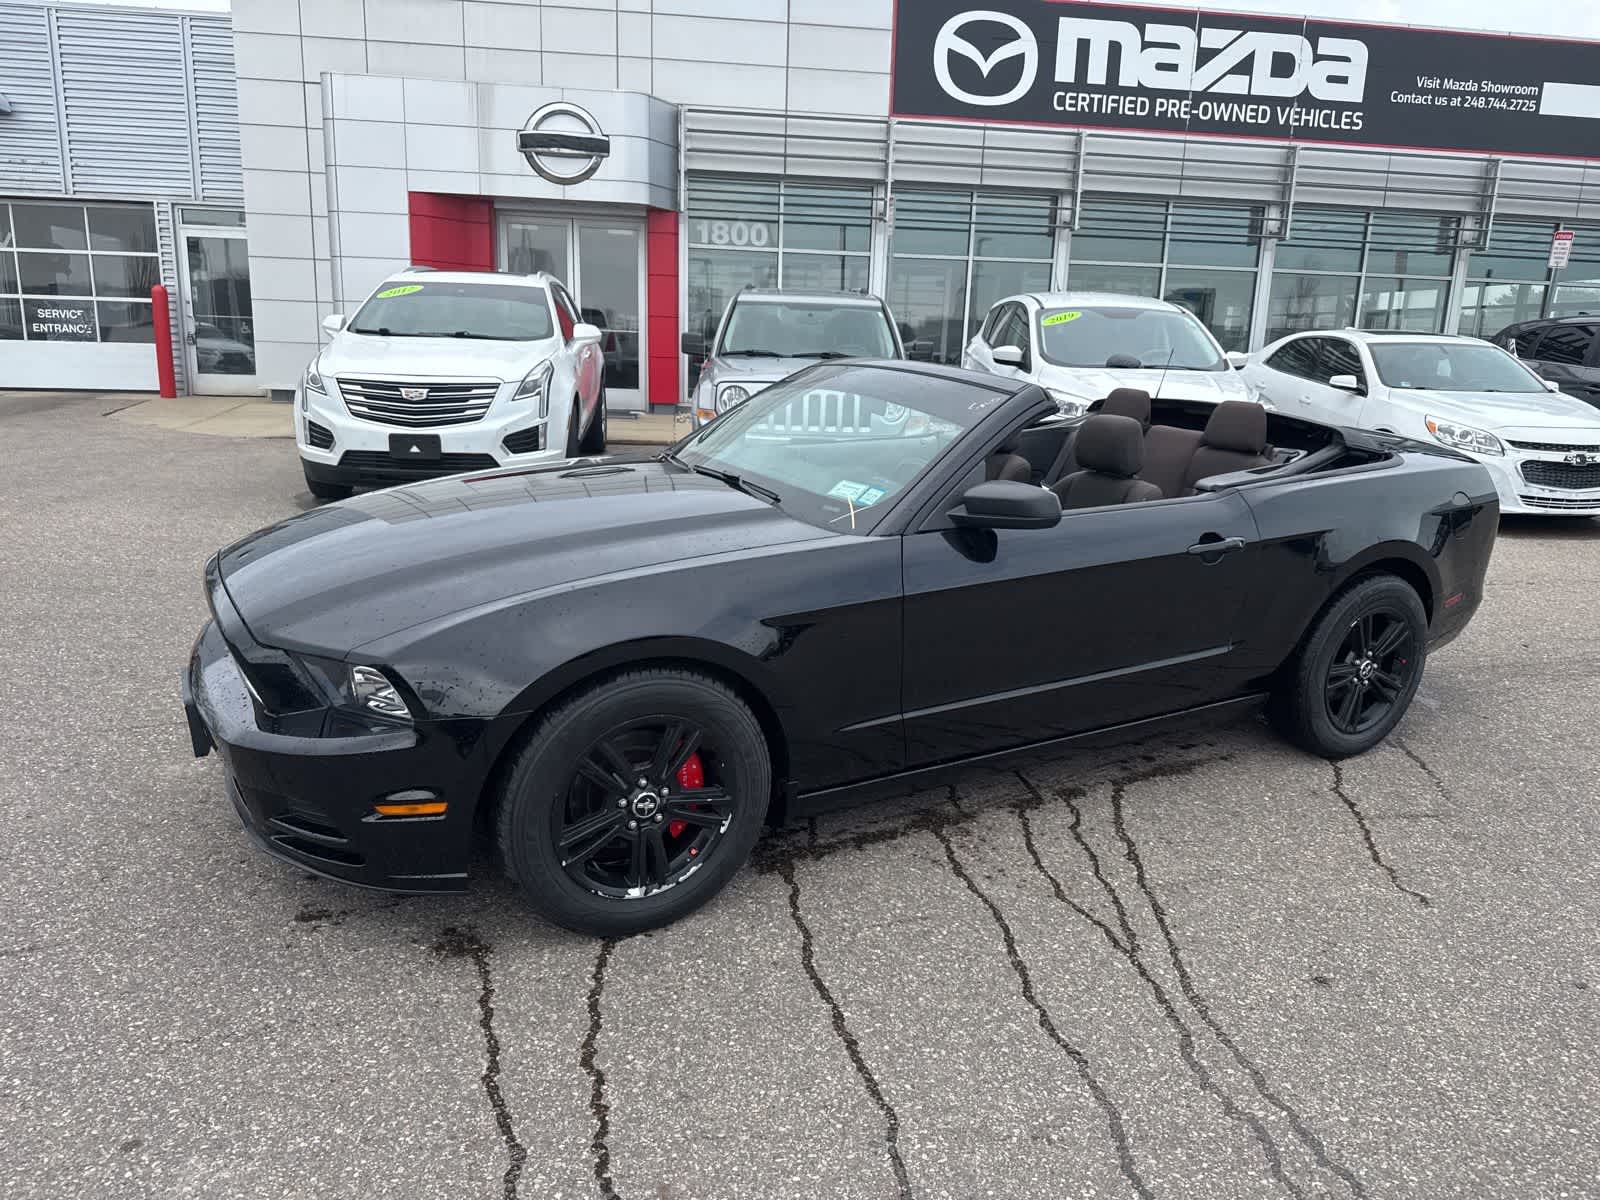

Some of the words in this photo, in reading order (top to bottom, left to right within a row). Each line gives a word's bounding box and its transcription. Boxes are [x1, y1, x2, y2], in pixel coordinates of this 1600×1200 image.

[1416, 76, 1441, 89] Visit
[1443, 78, 1478, 92] Mazda
[1480, 80, 1539, 96] Showroom
[1053, 91, 1150, 116] CERTIFIED
[1155, 98, 1271, 125] PRE-OWNED
[1276, 106, 1364, 131] VEHICLES
[1390, 91, 1432, 105] Contact
[1434, 95, 1448, 106] us
[1450, 96, 1461, 107] at
[1463, 96, 1537, 112] 248.744.2725
[696, 221, 769, 247] 1800
